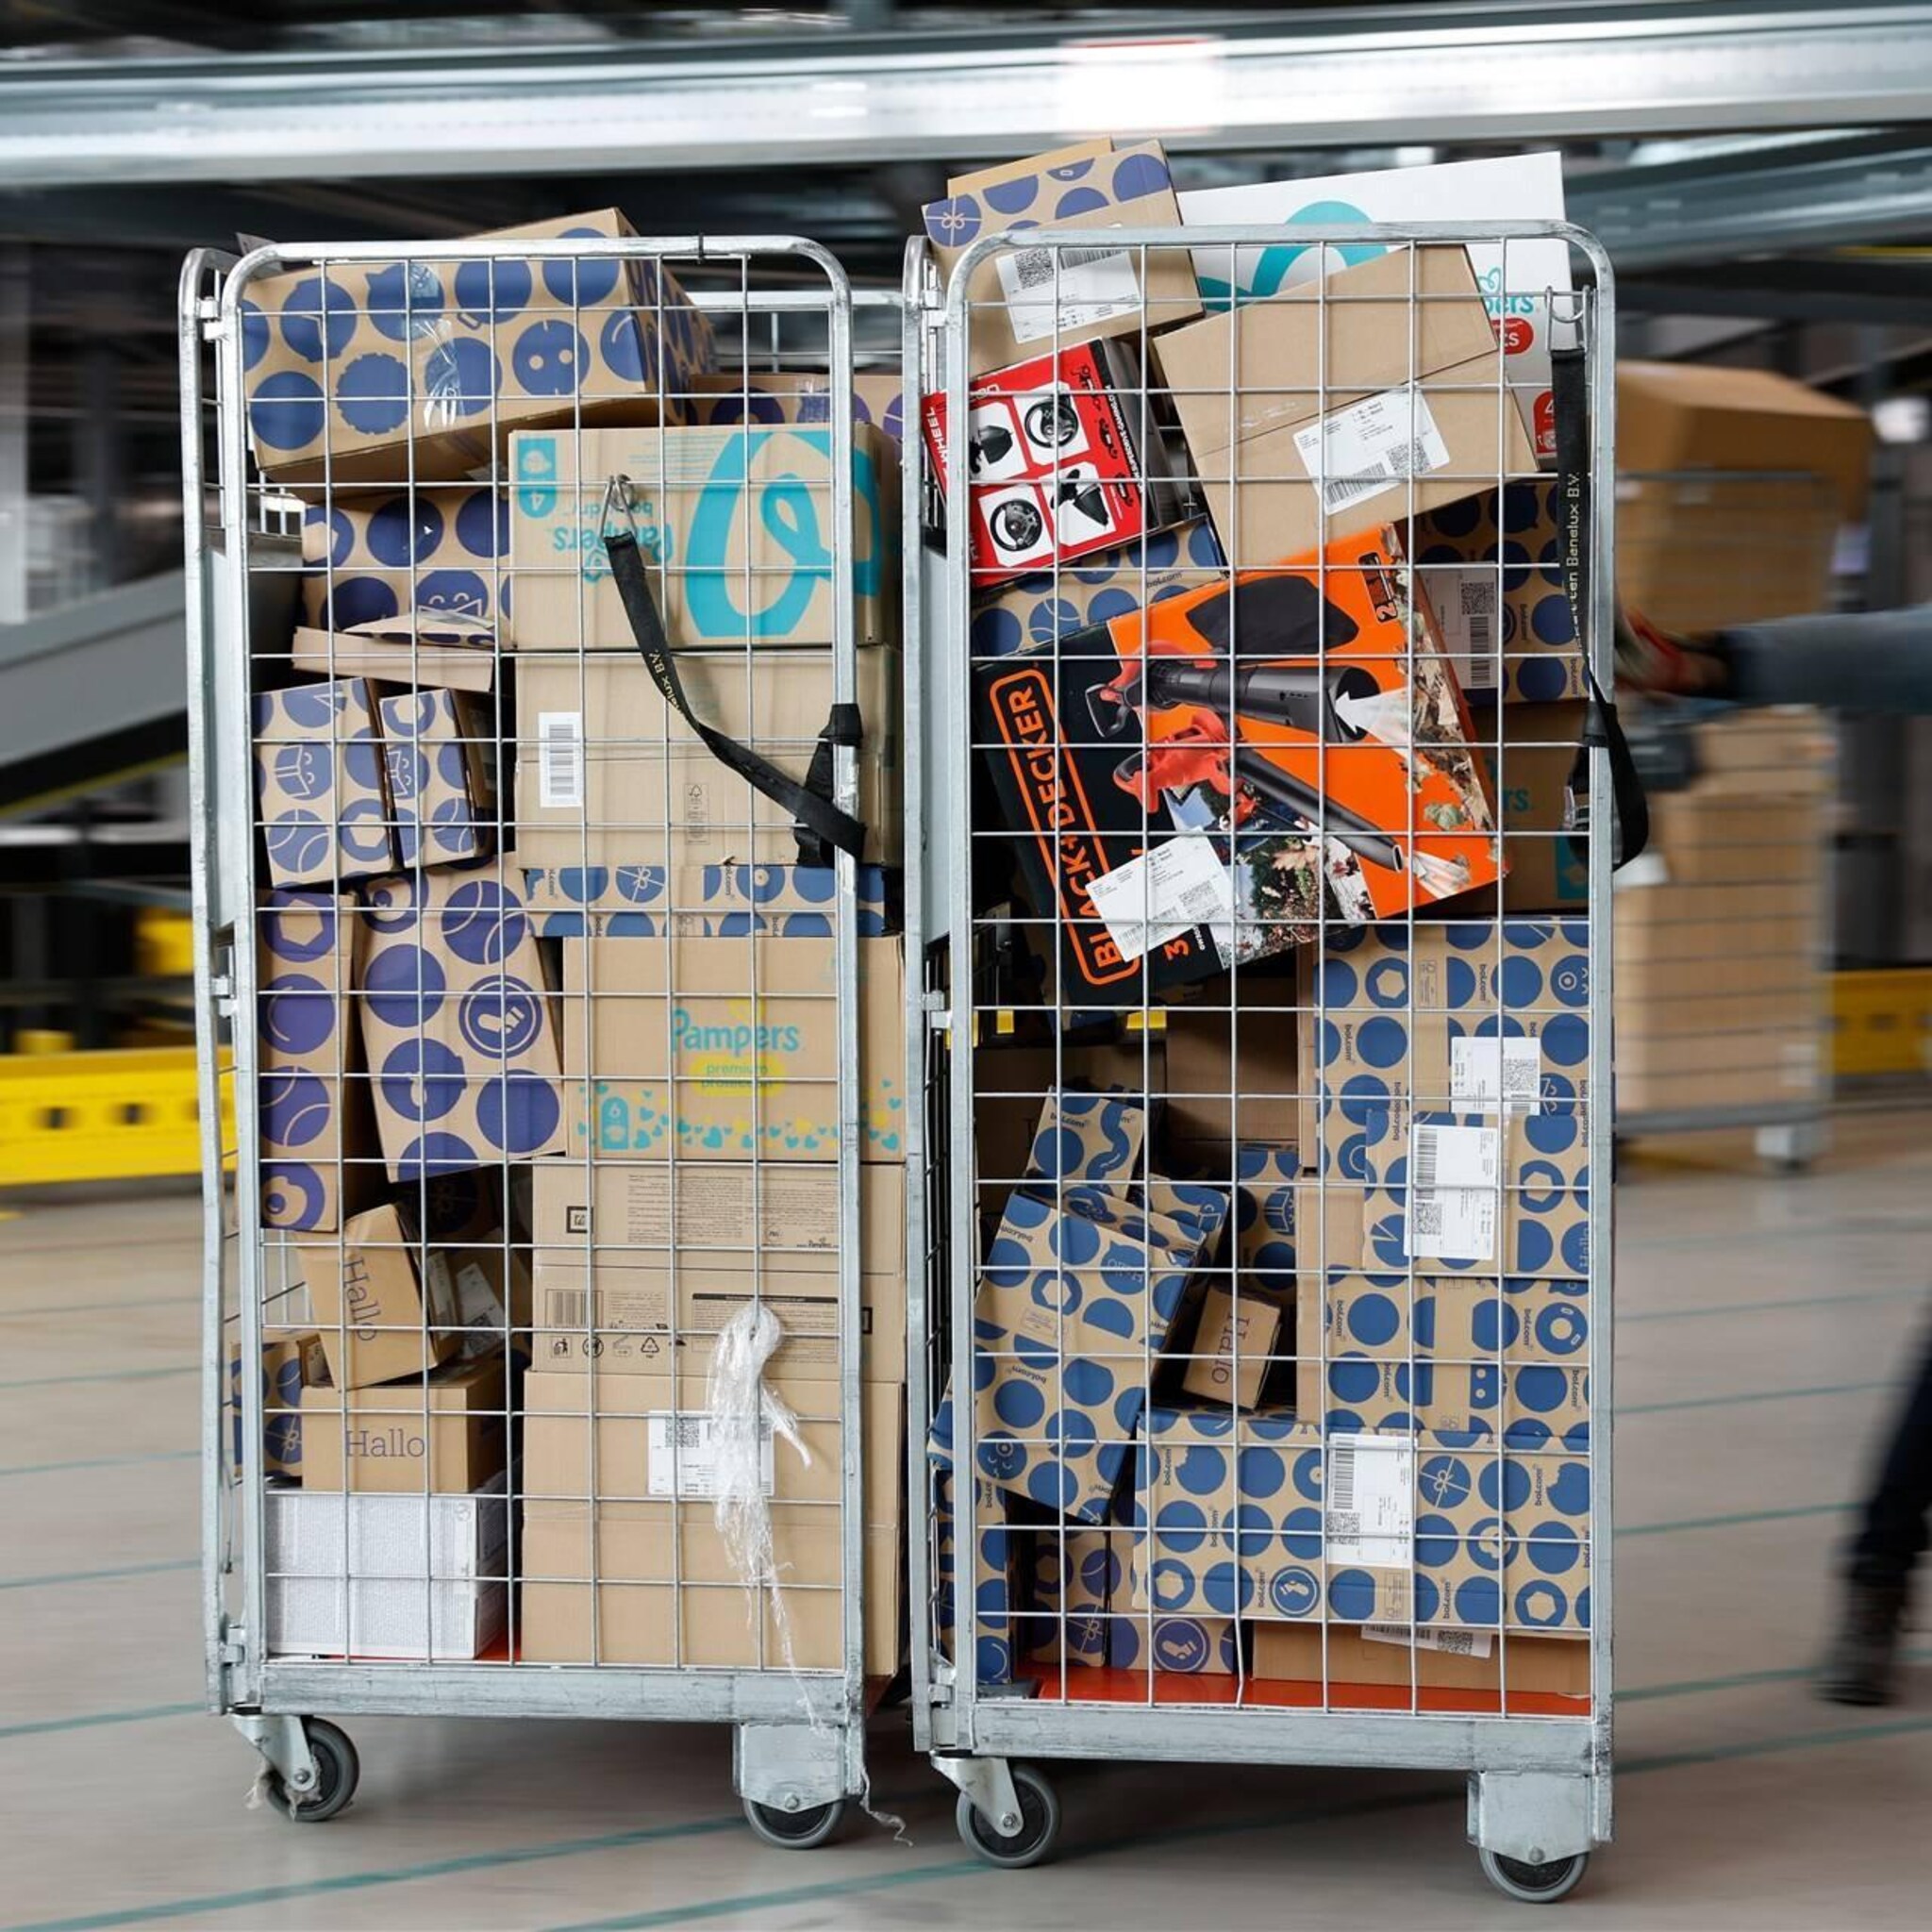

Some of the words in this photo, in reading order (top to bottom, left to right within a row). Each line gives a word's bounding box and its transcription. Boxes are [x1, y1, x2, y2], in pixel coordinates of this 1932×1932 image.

[1566, 502, 1581, 567] Benelux
[1479, 963, 1490, 1003] bol.com
[671, 1008, 800, 1058] Pampers
[1344, 1024, 1354, 1063] bol.com
[341, 1256, 381, 1341] Hallo
[1337, 1299, 1345, 1338] bol.com
[1524, 1307, 1532, 1346] bol.com
[1211, 1315, 1251, 1385] Hallo
[1010, 1364, 1048, 1385] bol.com
[1571, 1369, 1580, 1407] bol.com
[346, 1428, 425, 1457] Hallo
[1164, 1448, 1173, 1487] bol.com
[1535, 1467, 1544, 1507] bol.com
[1257, 1571, 1266, 1608] bol.com
[1442, 1580, 1452, 1620] bol.com
